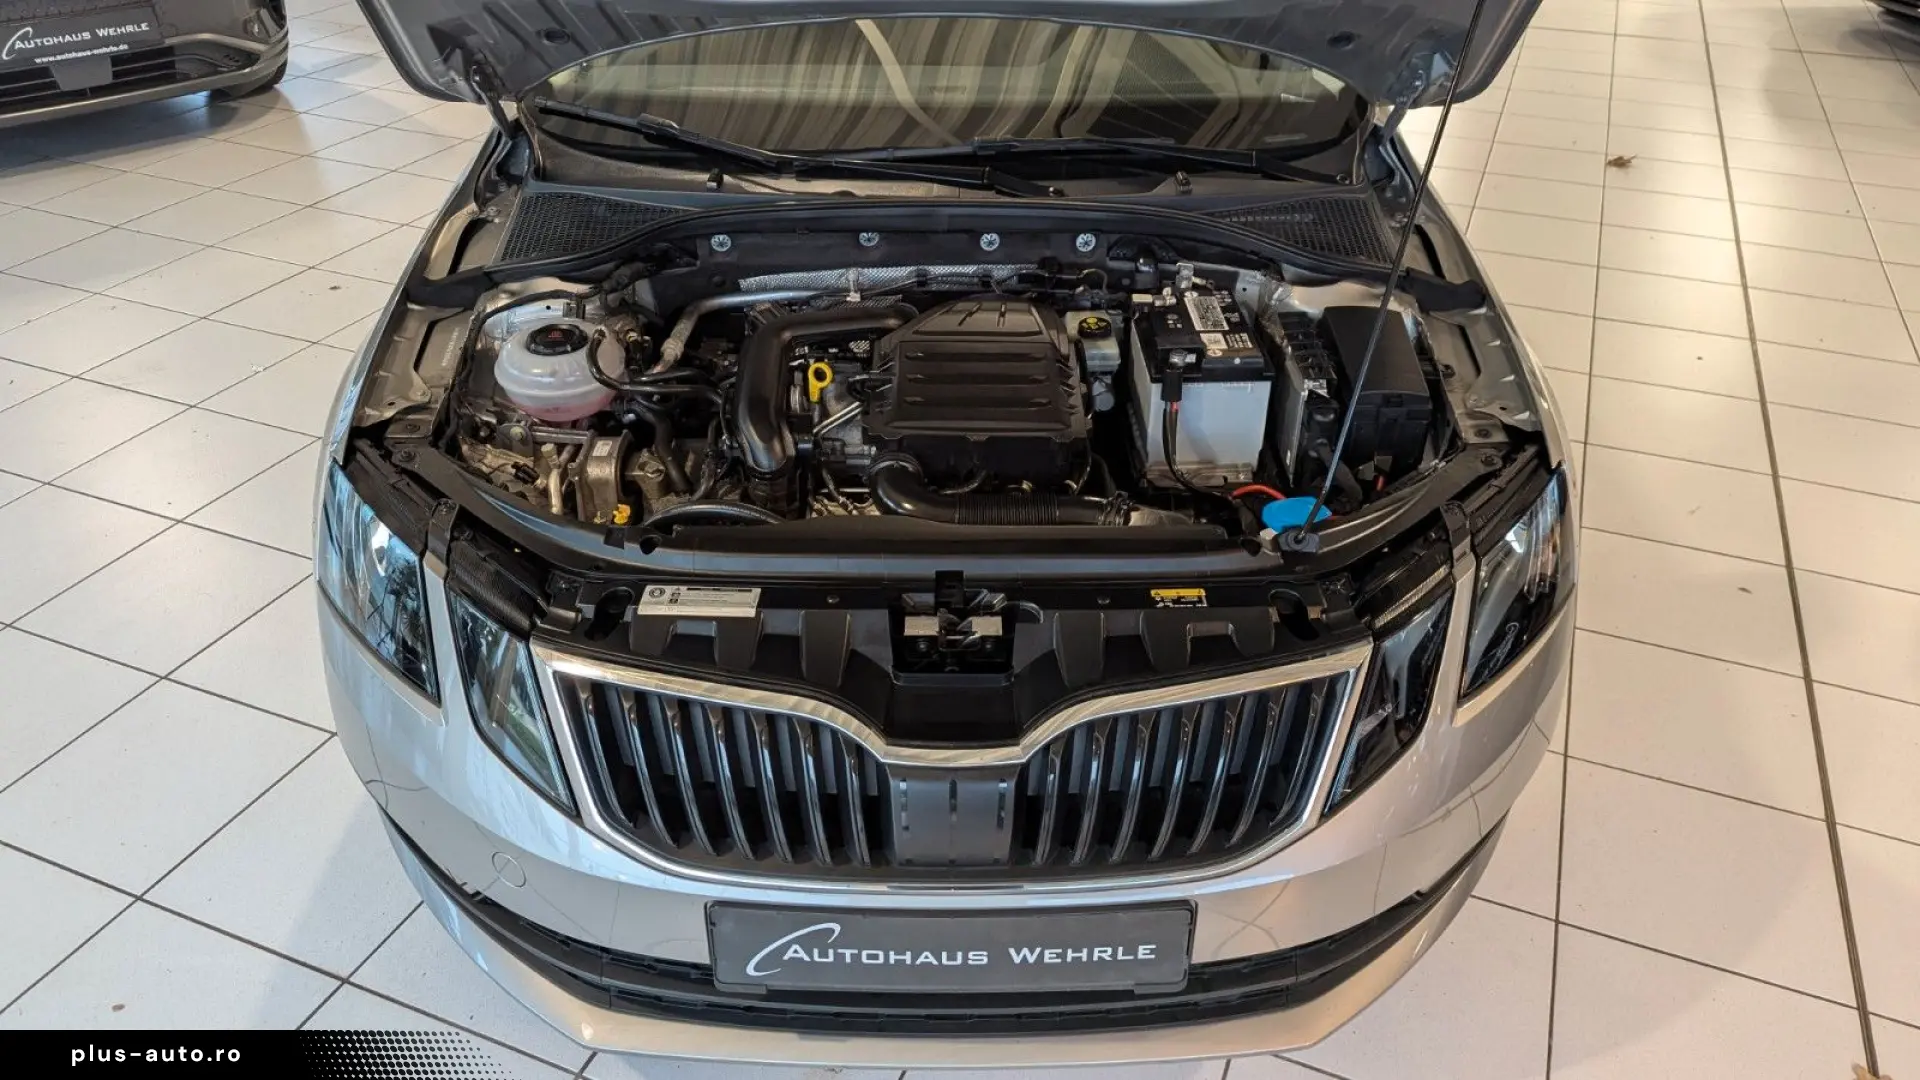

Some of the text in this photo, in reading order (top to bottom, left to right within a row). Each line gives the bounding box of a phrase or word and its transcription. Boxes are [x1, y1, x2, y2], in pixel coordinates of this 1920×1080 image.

[95, 22, 150, 37] WEHRLE
[782, 943, 1157, 966] AUTOHAUS WEHRLE
